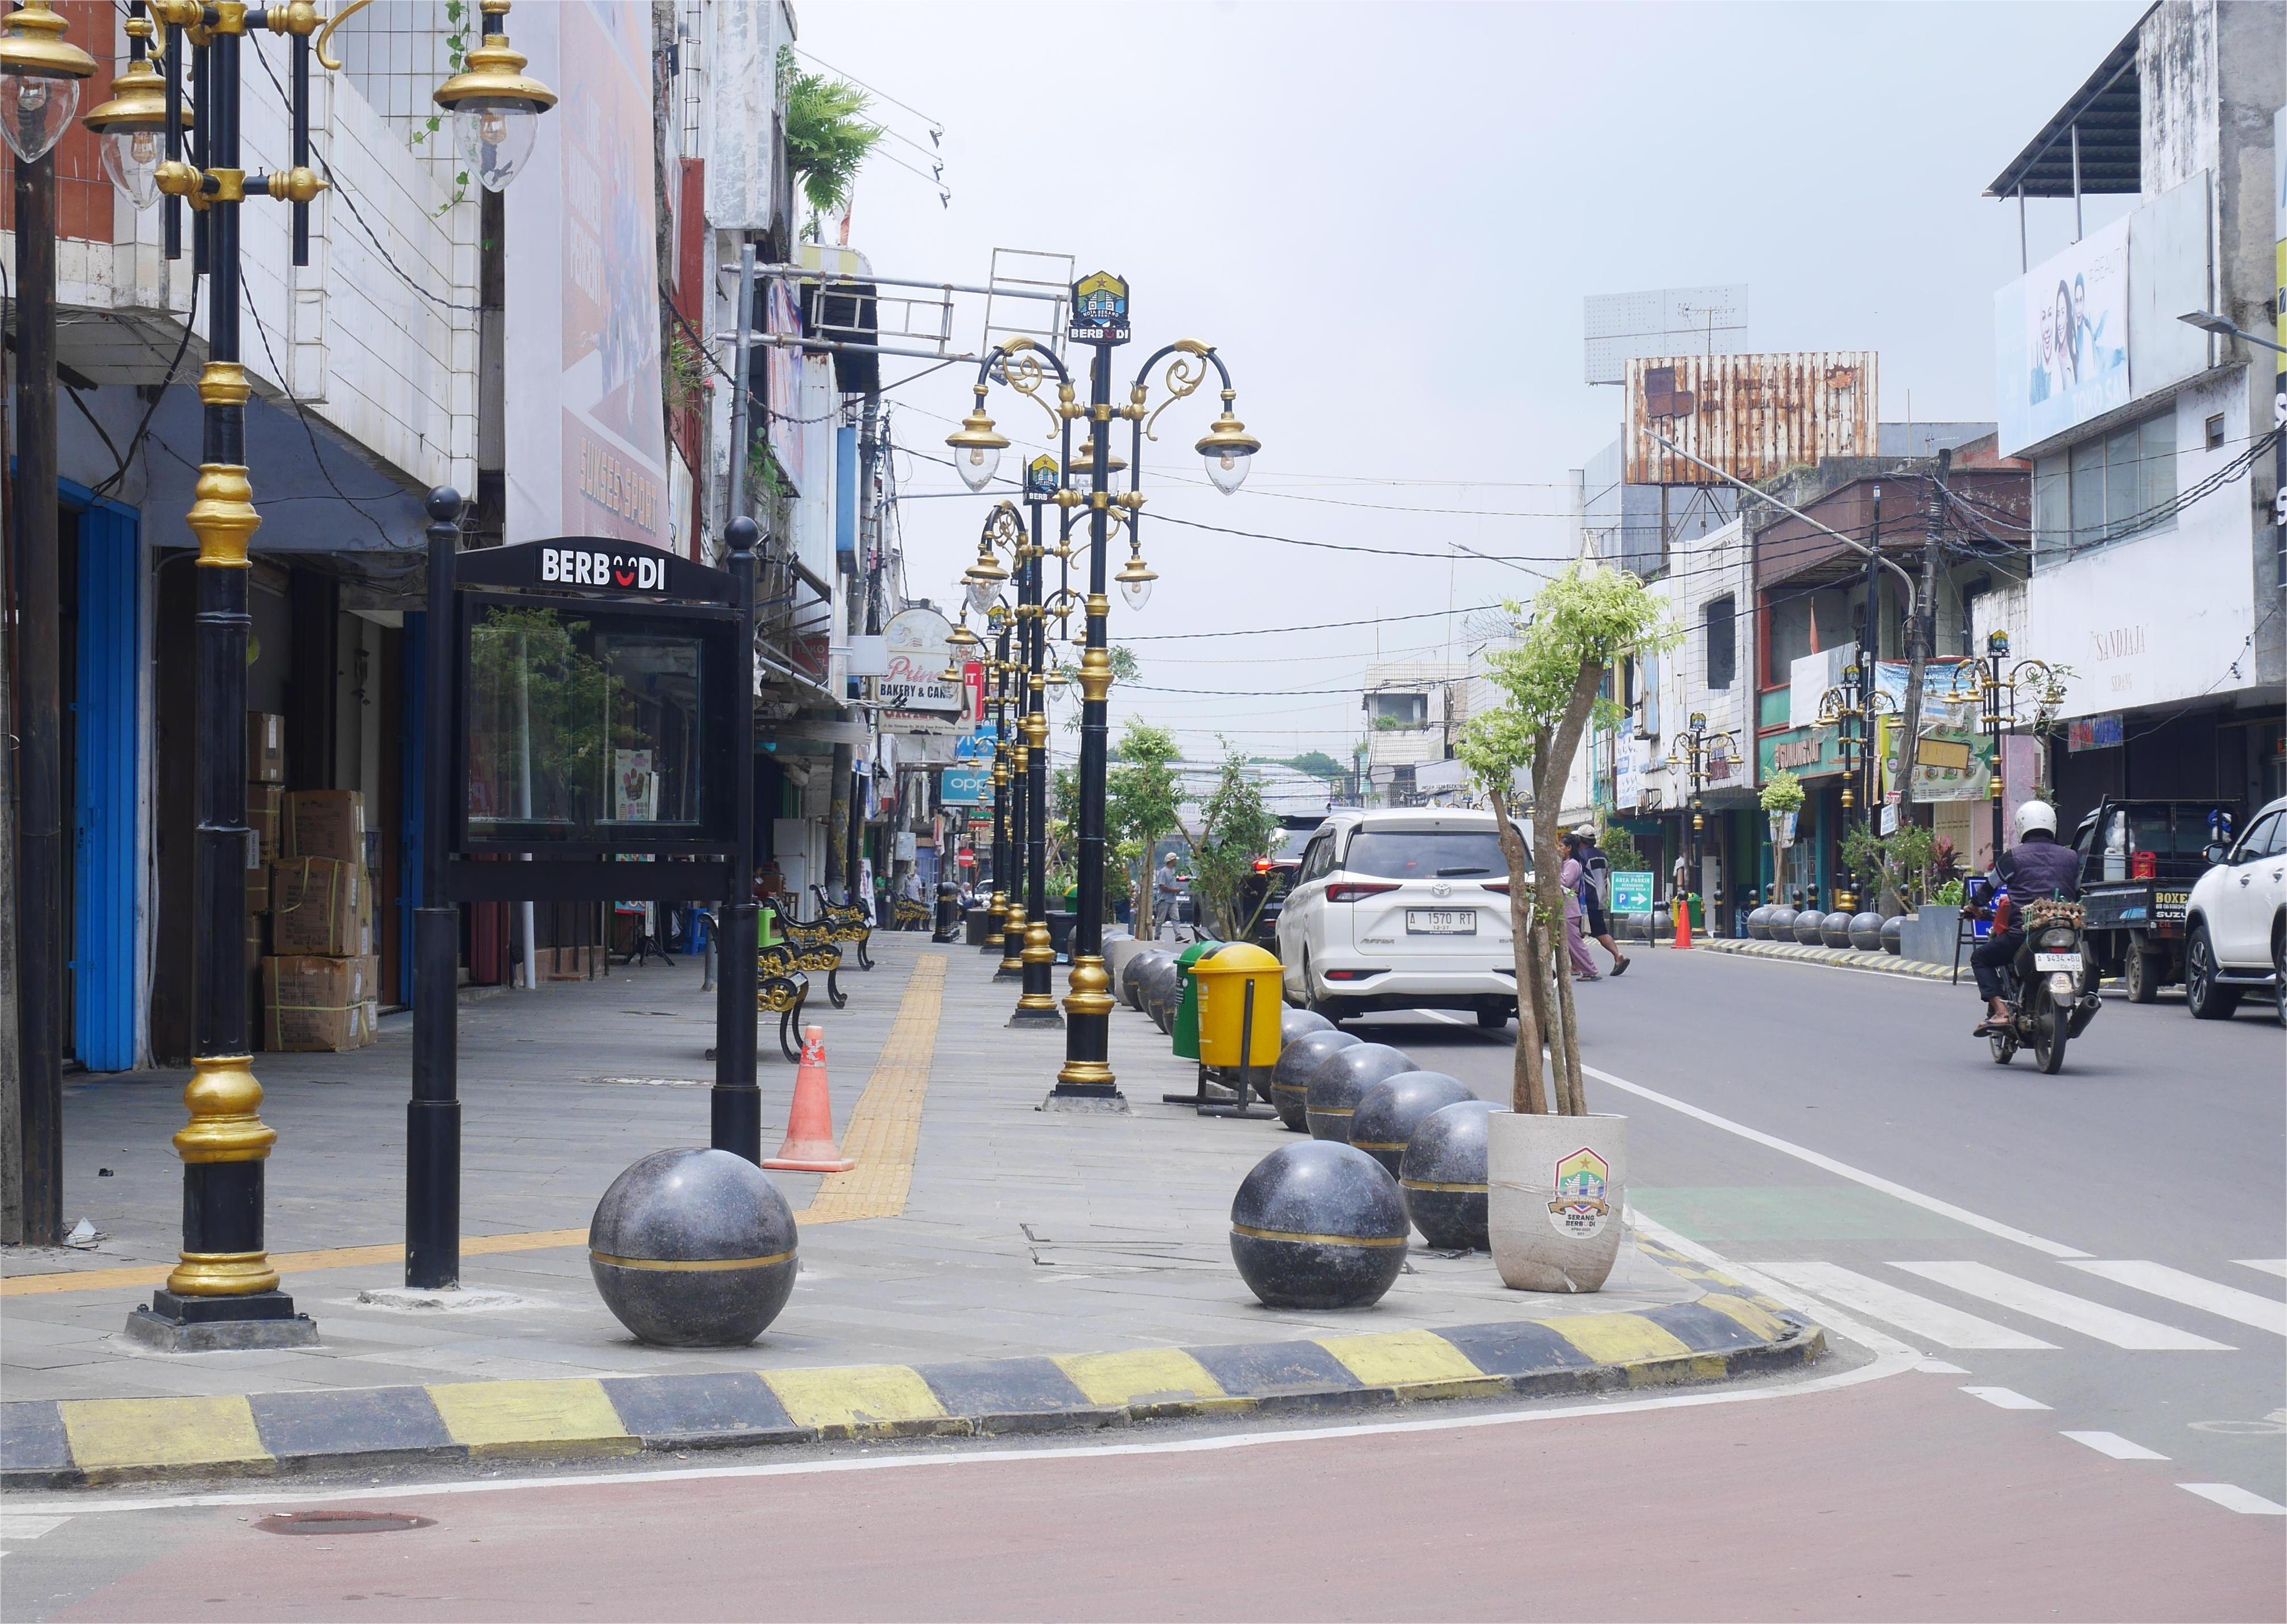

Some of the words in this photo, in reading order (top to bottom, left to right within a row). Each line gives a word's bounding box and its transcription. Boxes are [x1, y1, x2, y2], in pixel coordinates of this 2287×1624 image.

[570, 215, 601, 308] PERCENT
[580, 436, 621, 513] SUKSES
[624, 467, 657, 534] SPORT
[880, 683, 916, 697] BAKERY
[917, 687, 925, 698] &
[927, 685, 948, 699] CAK
[951, 778, 988, 791] opp
[1619, 894, 1626, 903] P
[1410, 913, 1416, 924] A
[1428, 912, 1451, 924] 1570
[1459, 913, 1472, 924] RT
